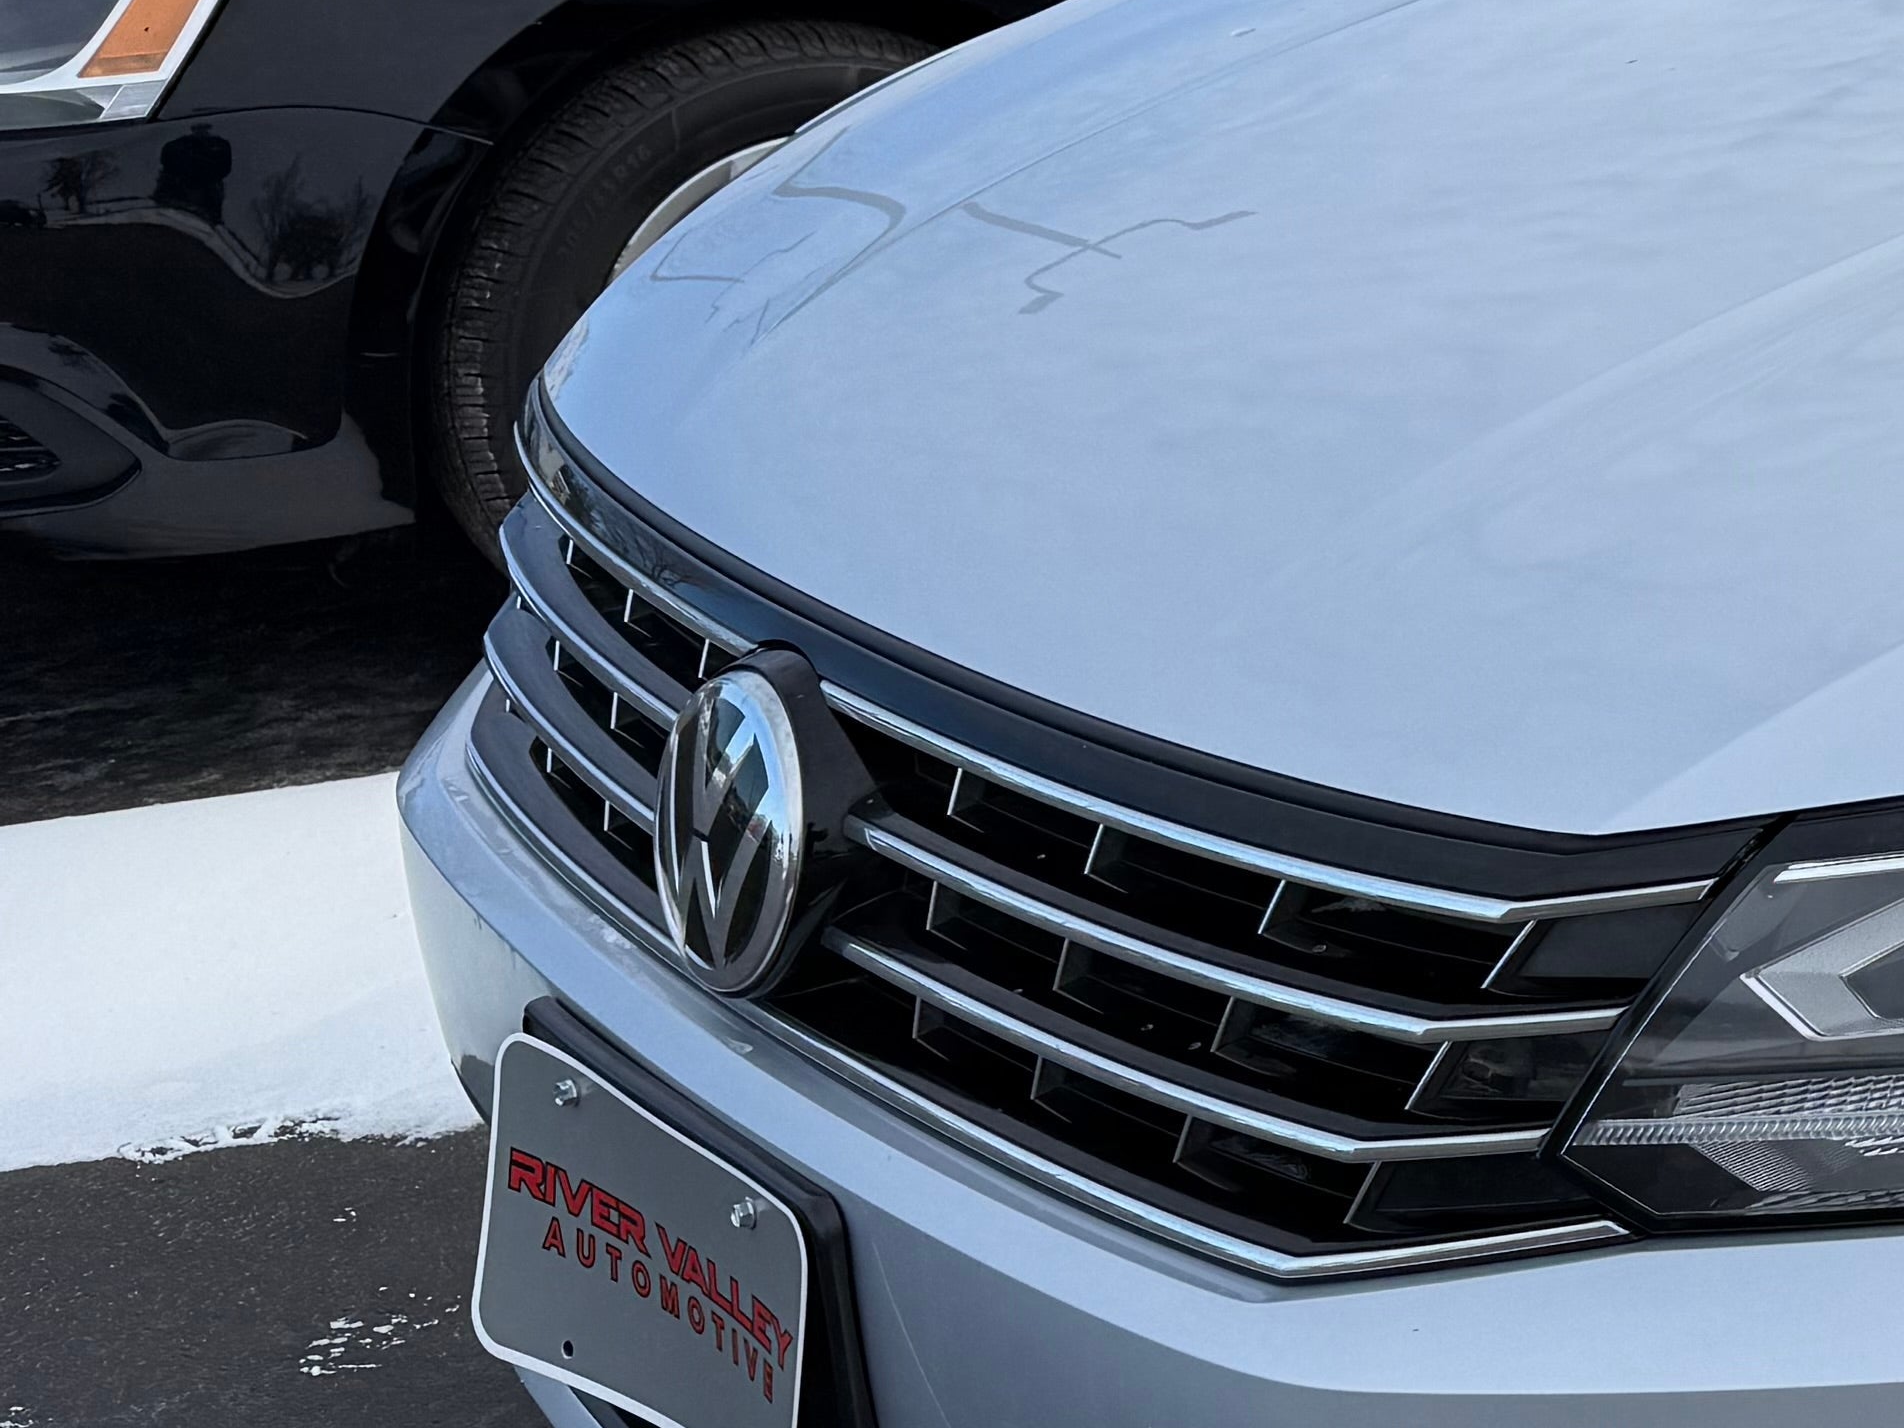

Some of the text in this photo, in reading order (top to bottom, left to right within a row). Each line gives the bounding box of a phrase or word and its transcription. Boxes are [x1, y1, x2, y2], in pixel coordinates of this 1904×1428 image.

[507, 1146, 793, 1371] RIVER VALLEY
[542, 1216, 774, 1405] AUTOMOTIVE
